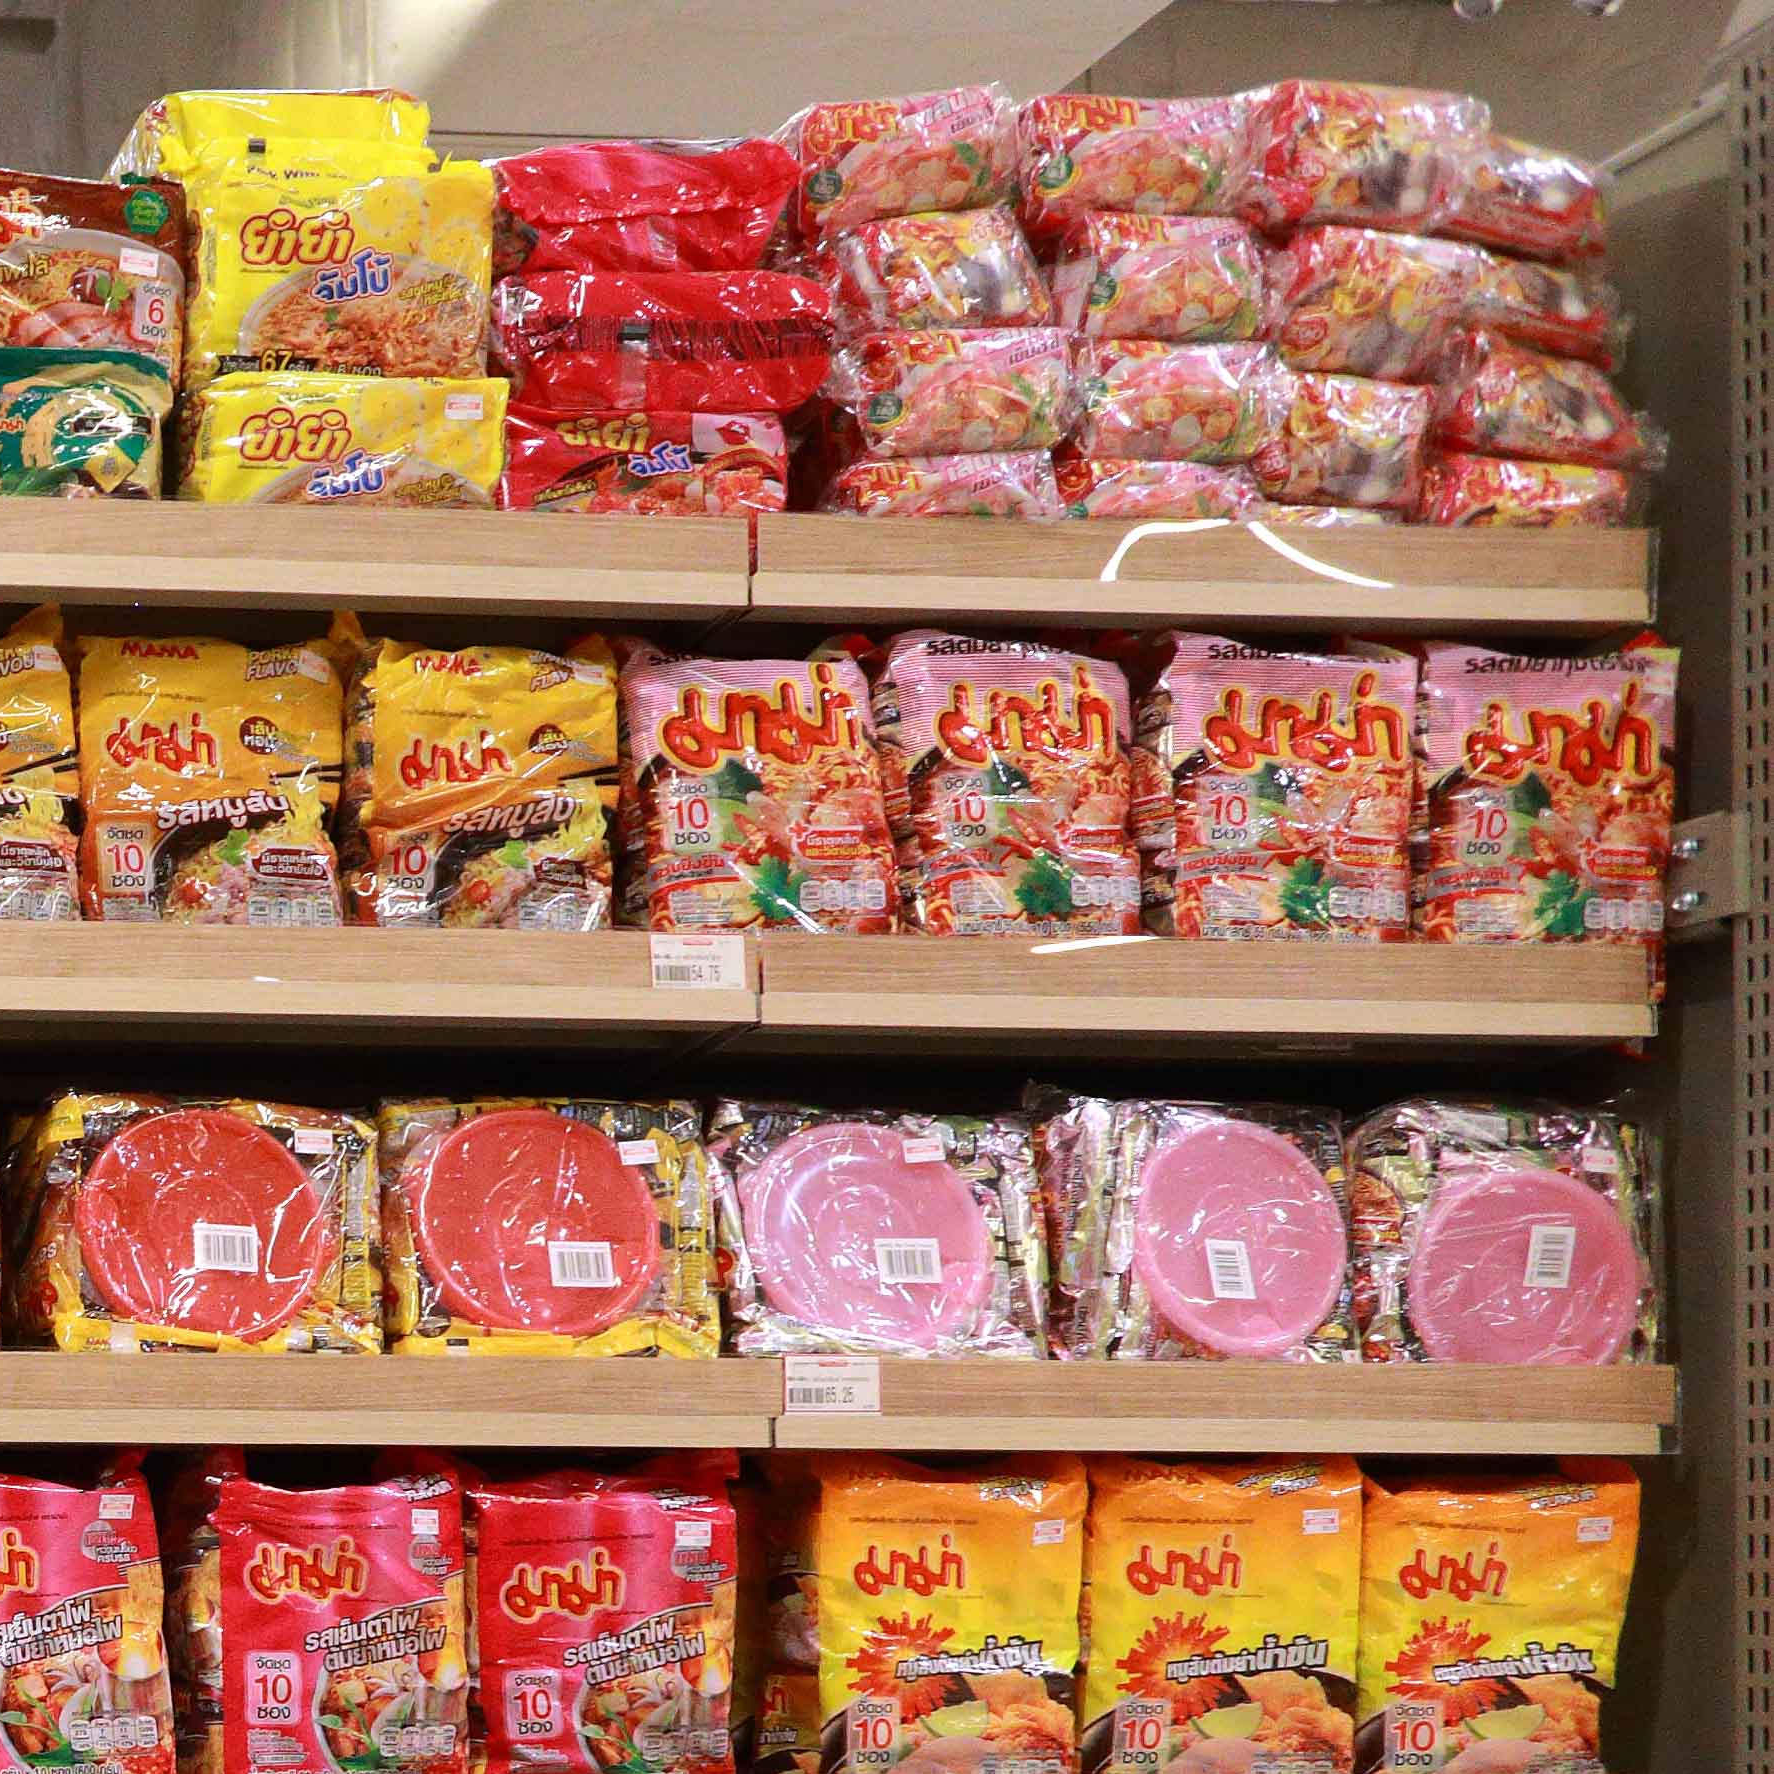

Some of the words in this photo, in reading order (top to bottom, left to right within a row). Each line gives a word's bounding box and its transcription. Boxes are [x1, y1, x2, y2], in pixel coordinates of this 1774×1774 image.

[240, 212, 353, 272] ยำยำ
[310, 249, 392, 304] จัมโบ้
[147, 297, 167, 325] 6
[120, 639, 199, 660] MAMA
[663, 662, 852, 765] มาม่า
[1464, 684, 1653, 778] มาม่า
[157, 789, 289, 829] รสหมูสับ
[669, 802, 710, 831] 10
[1206, 794, 1250, 827] 10
[105, 843, 143, 872] 10
[1125, 1534, 1242, 1598] มาม่า
[505, 1550, 624, 1621] มาม่า
[257, 1676, 292, 1703] 10
[256, 1702, 291, 1719] ซอง
[515, 1692, 552, 1719] 10
[516, 1718, 555, 1736] ซอง
[854, 1718, 892, 1748] 10
[1123, 1718, 1161, 1749] 10
[1393, 1720, 1434, 1751] 10
